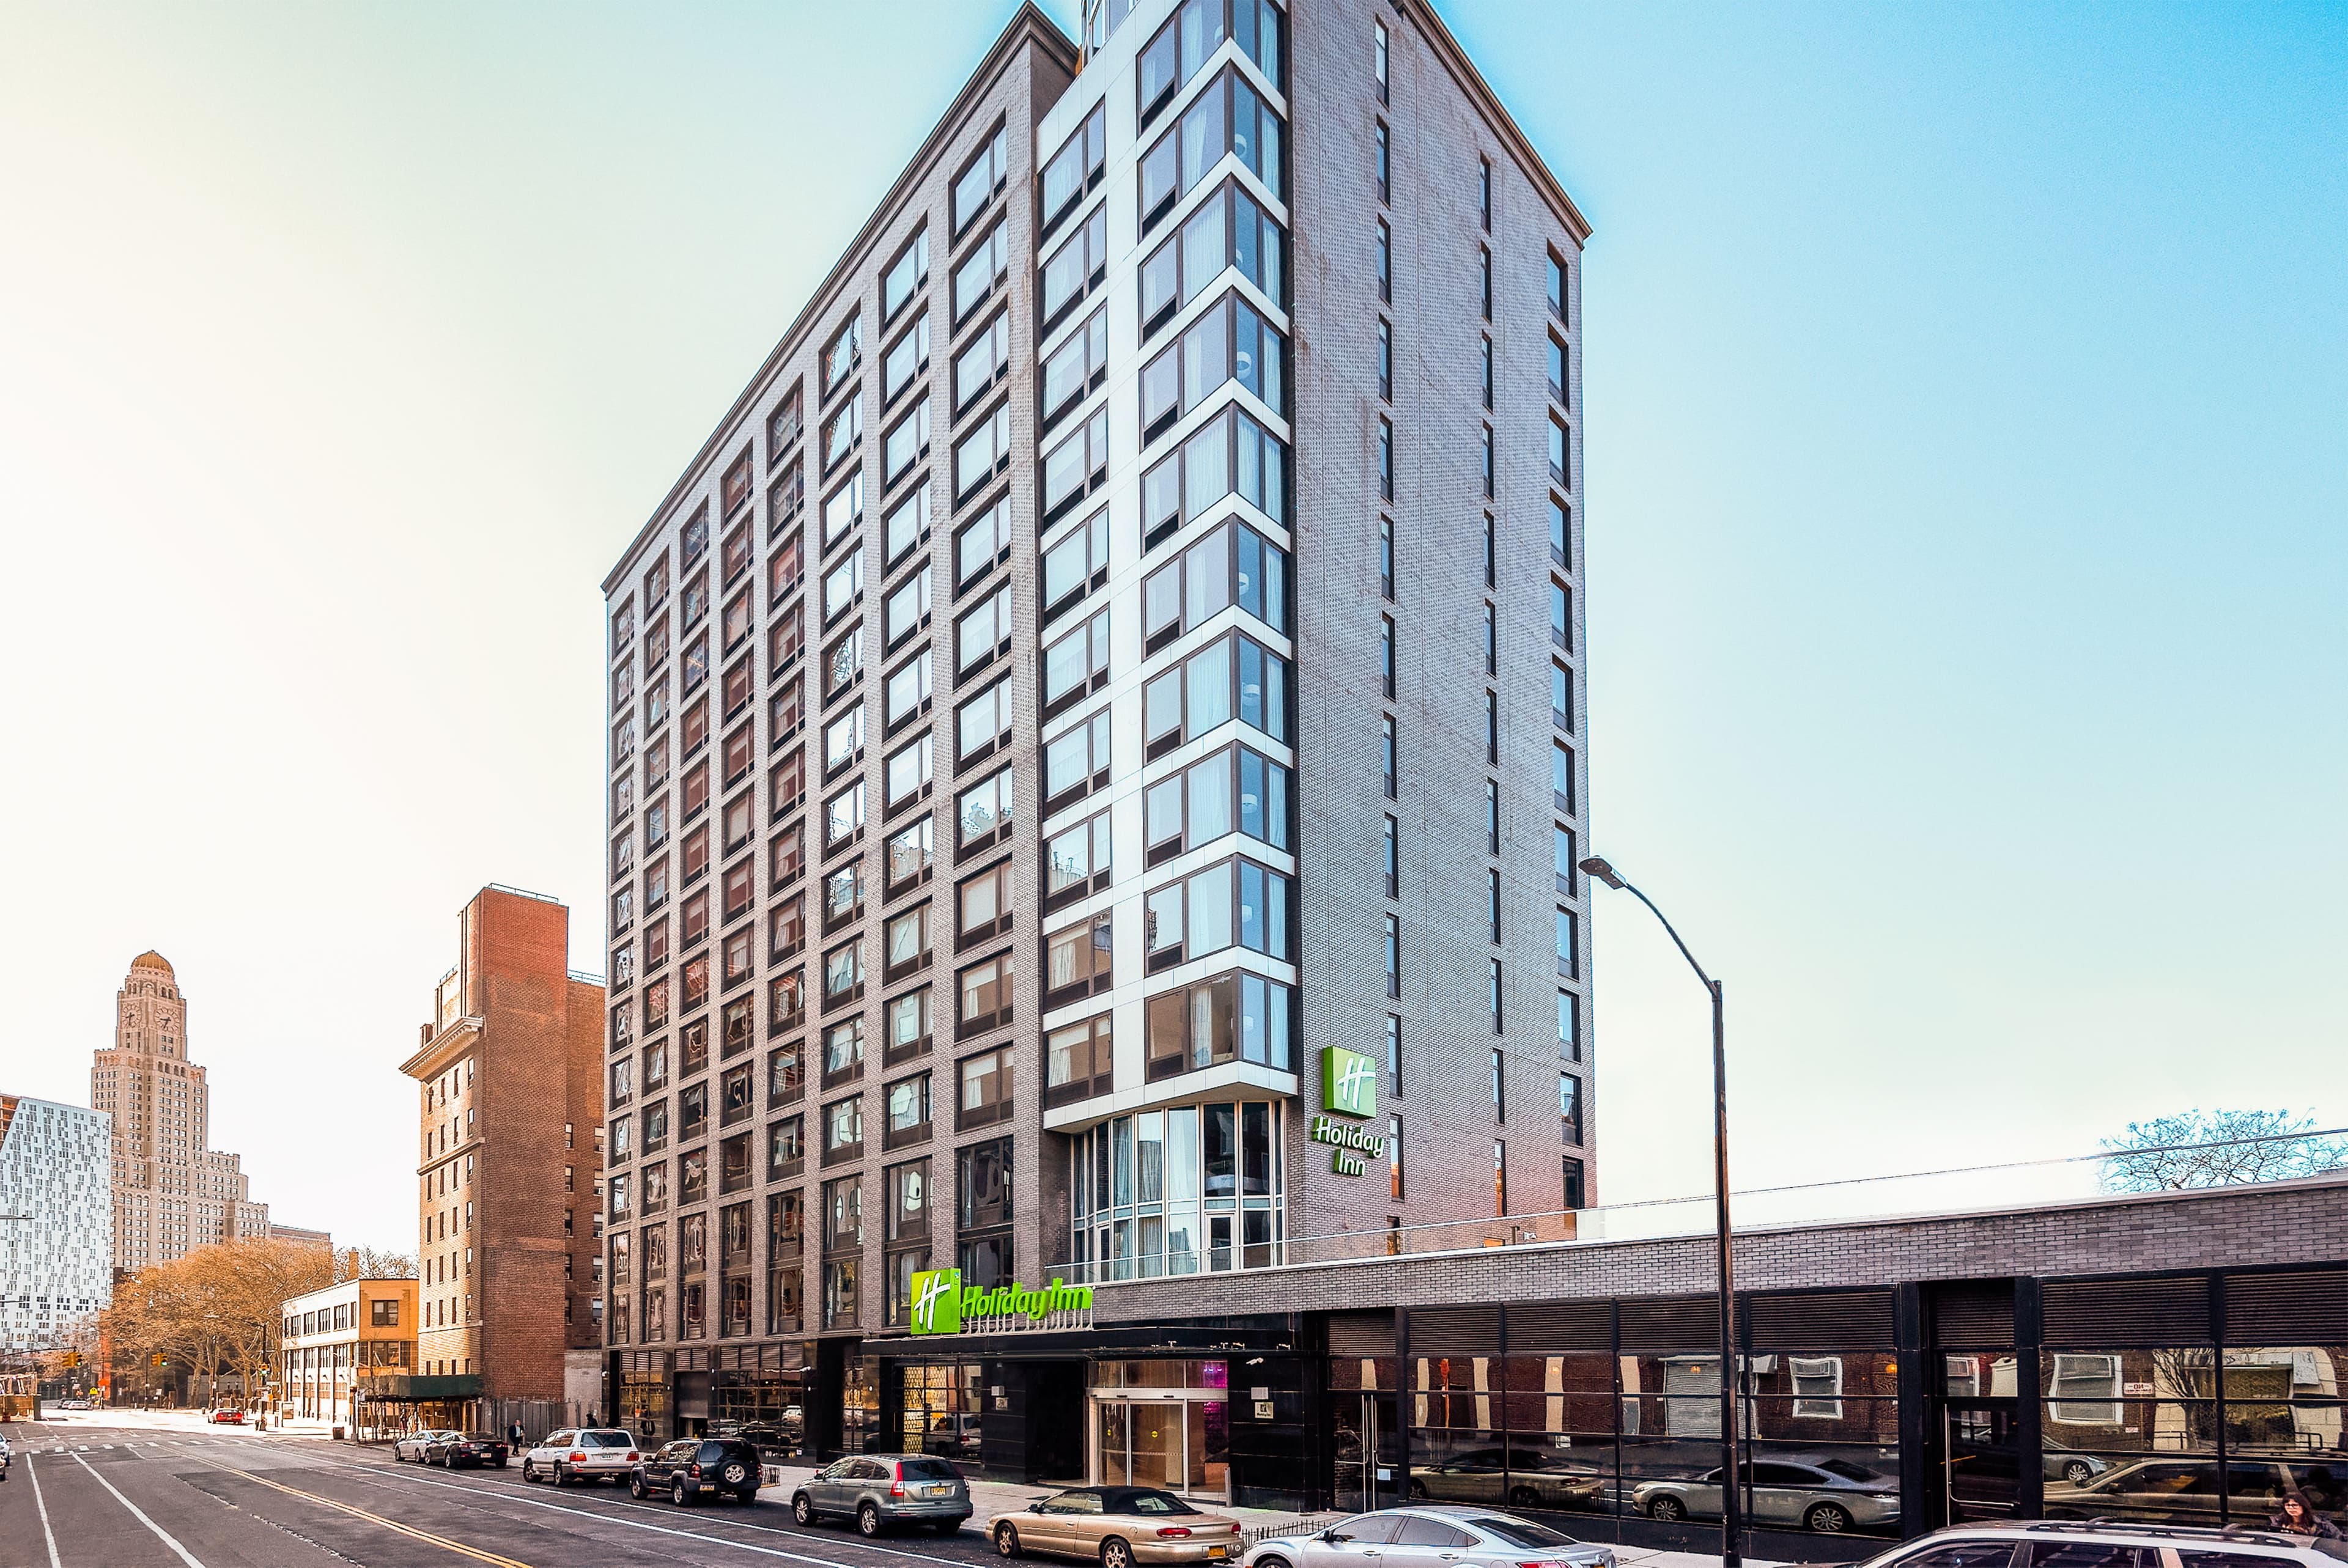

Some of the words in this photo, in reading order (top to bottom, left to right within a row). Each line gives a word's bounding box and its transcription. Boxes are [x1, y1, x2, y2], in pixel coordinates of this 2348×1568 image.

[1314, 1116, 1385, 1158] Holiday
[1335, 1148, 1365, 1176] Inn
[961, 1282, 1050, 1320] Holiday
[1050, 1277, 1093, 1311] Inn
